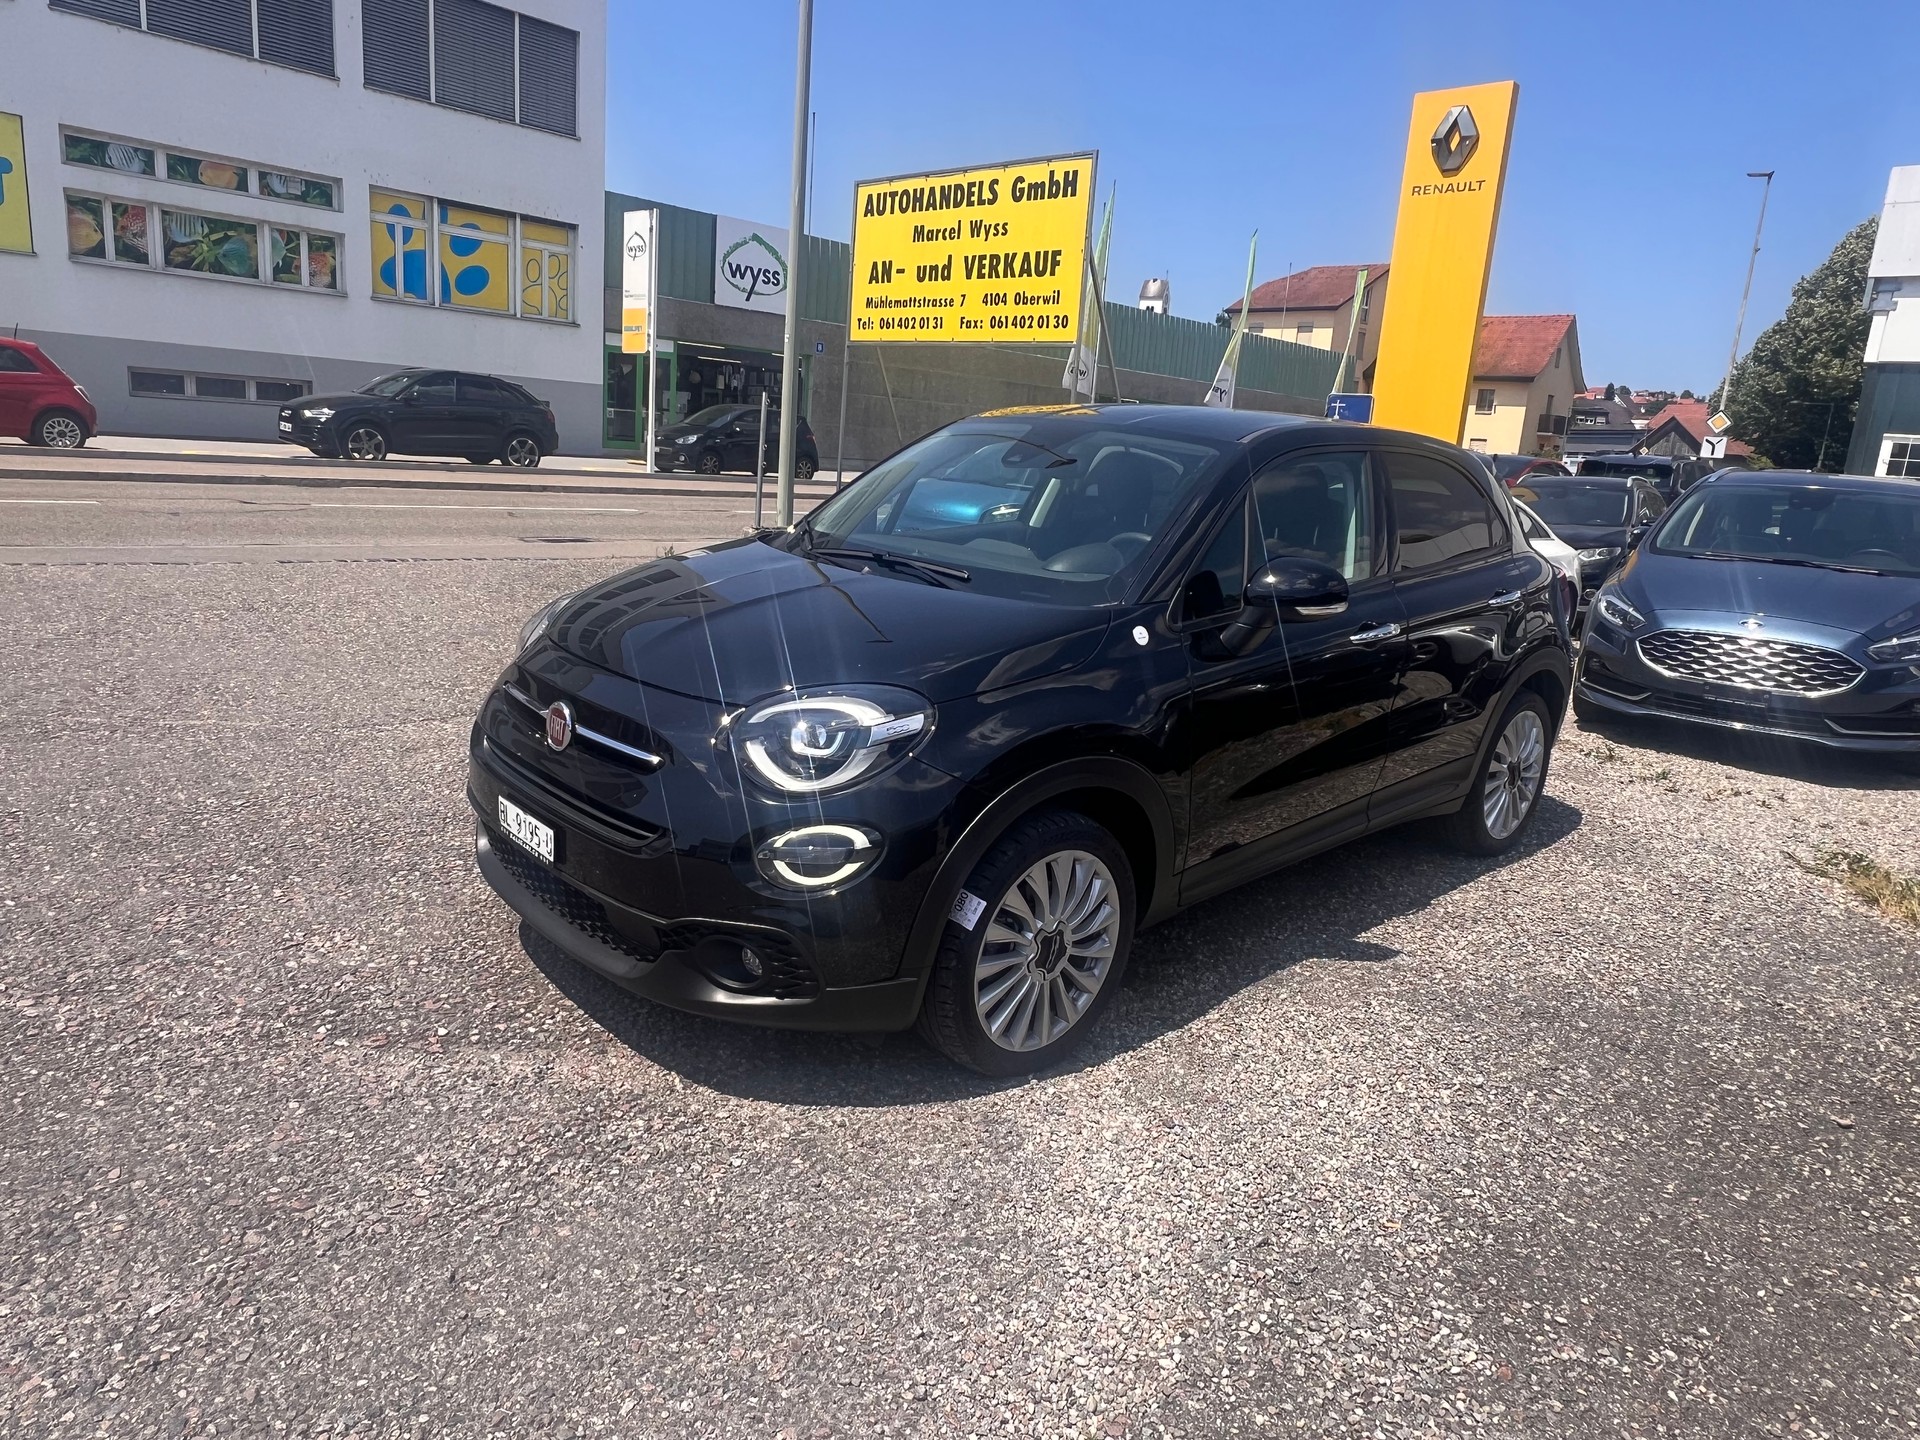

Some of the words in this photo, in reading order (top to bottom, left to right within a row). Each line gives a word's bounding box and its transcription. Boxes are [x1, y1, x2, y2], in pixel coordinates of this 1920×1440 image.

[863, 179, 999, 217] AUTOHANDELS
[1011, 170, 1079, 203] GmbH
[1411, 180, 1486, 196] RENAULT
[912, 220, 961, 243] Marcel
[969, 219, 1008, 241] Wyss
[628, 245, 644, 261] wyss
[916, 254, 952, 283] und
[963, 250, 1062, 280] VERKAUF
[727, 260, 780, 302] wyss
[865, 294, 954, 309] Mühlemattstrasse
[960, 294, 966, 307] 7
[982, 292, 1007, 306] 4104
[1014, 290, 1060, 306] Oberwil
[857, 316, 874, 330] Tel:
[959, 316, 983, 329] Fax:
[550, 714, 565, 741] FIAT
